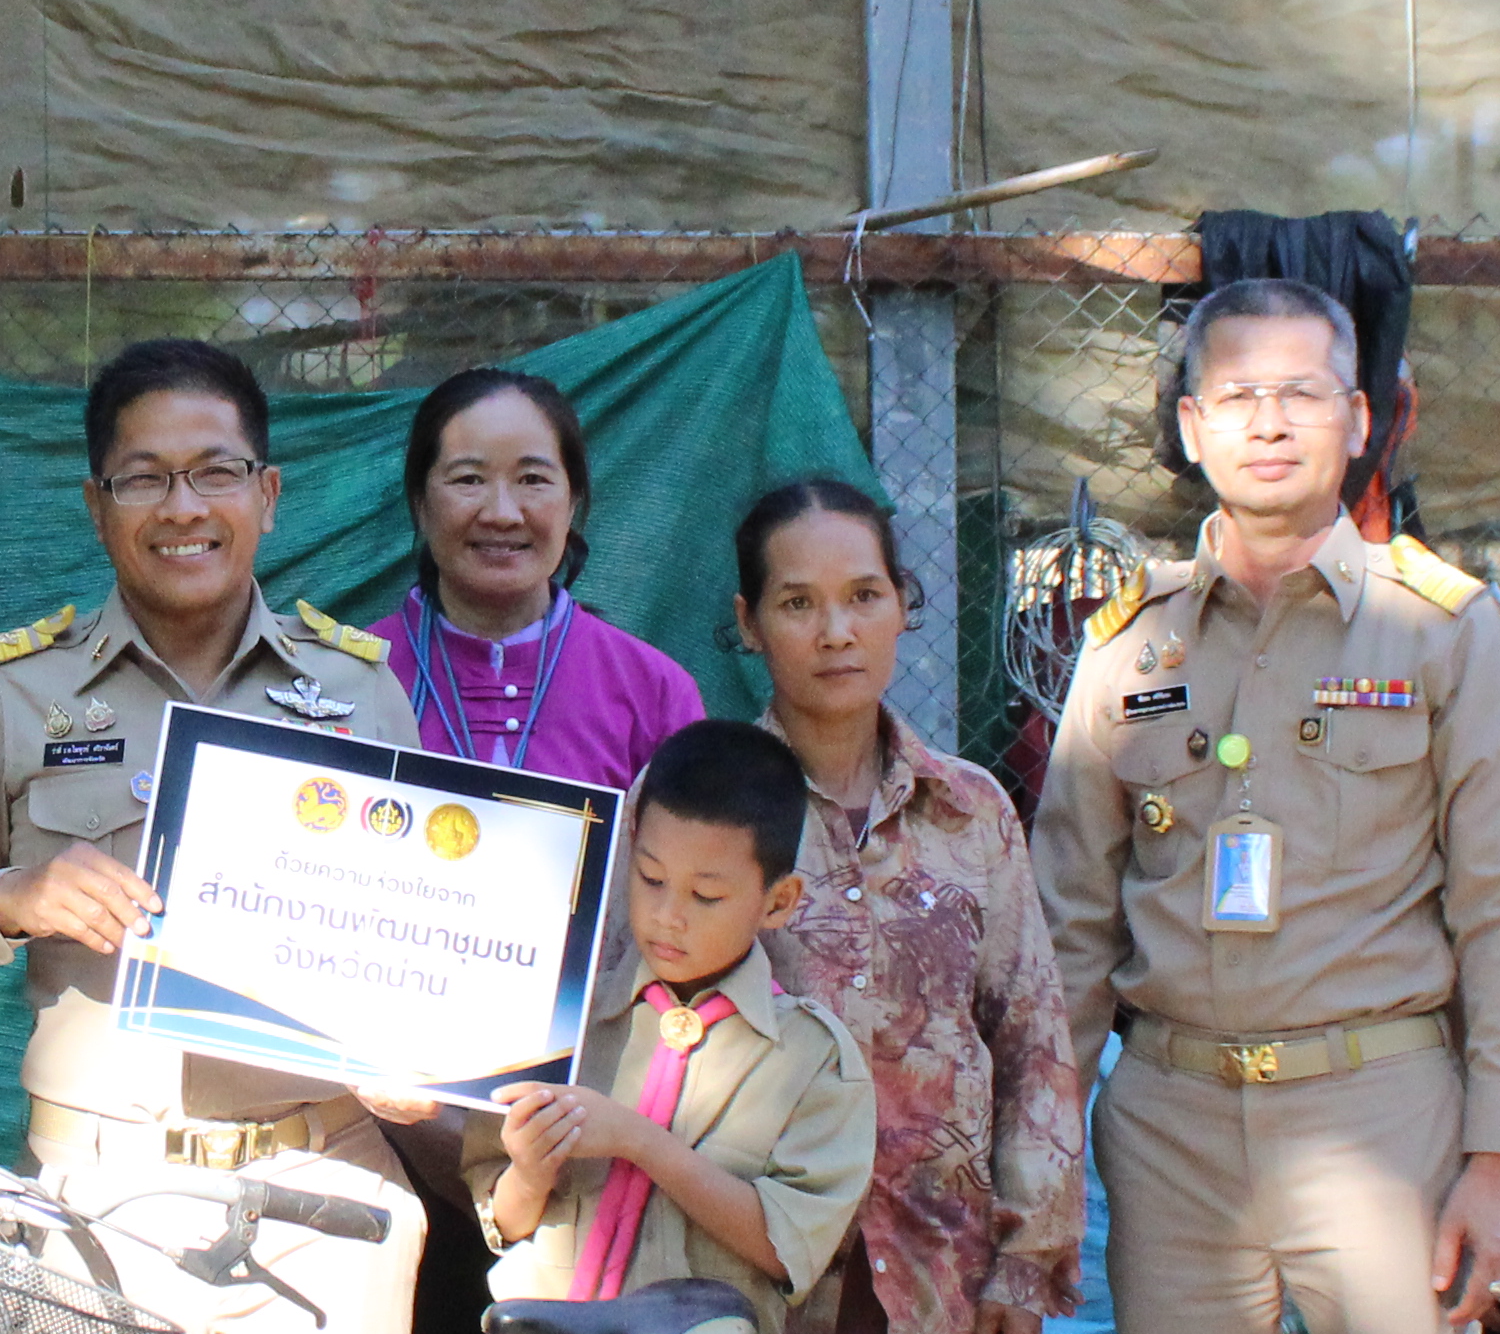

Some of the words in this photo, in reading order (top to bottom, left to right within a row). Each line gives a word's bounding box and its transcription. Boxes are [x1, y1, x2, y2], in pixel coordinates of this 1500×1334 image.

[273, 936, 448, 997] จังหวัดน่าน
